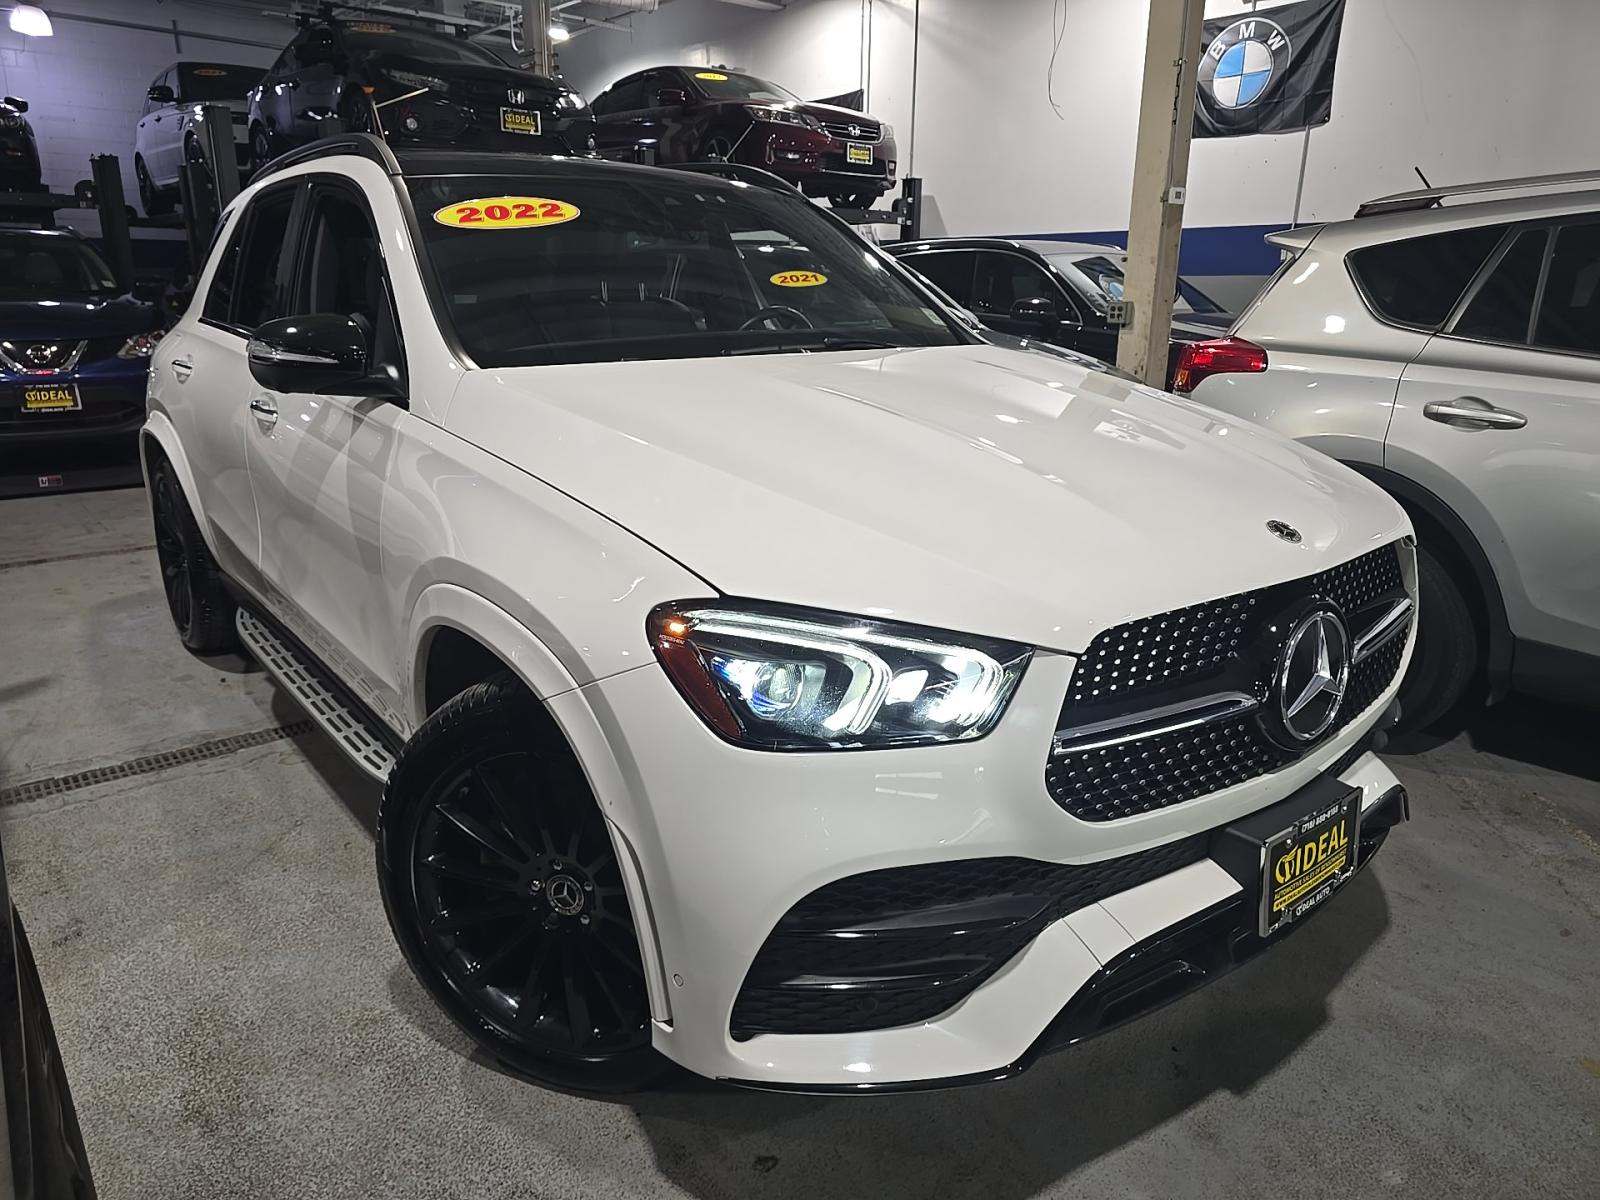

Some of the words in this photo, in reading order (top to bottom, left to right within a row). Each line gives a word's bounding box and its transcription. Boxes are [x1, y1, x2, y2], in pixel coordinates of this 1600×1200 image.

[1208, 21, 1286, 61] BMW
[512, 114, 535, 124] IDEAL
[456, 202, 565, 224] 2022
[778, 274, 819, 284] 2021
[36, 390, 73, 401] IDEAL
[1295, 819, 1348, 877] IDEAL
